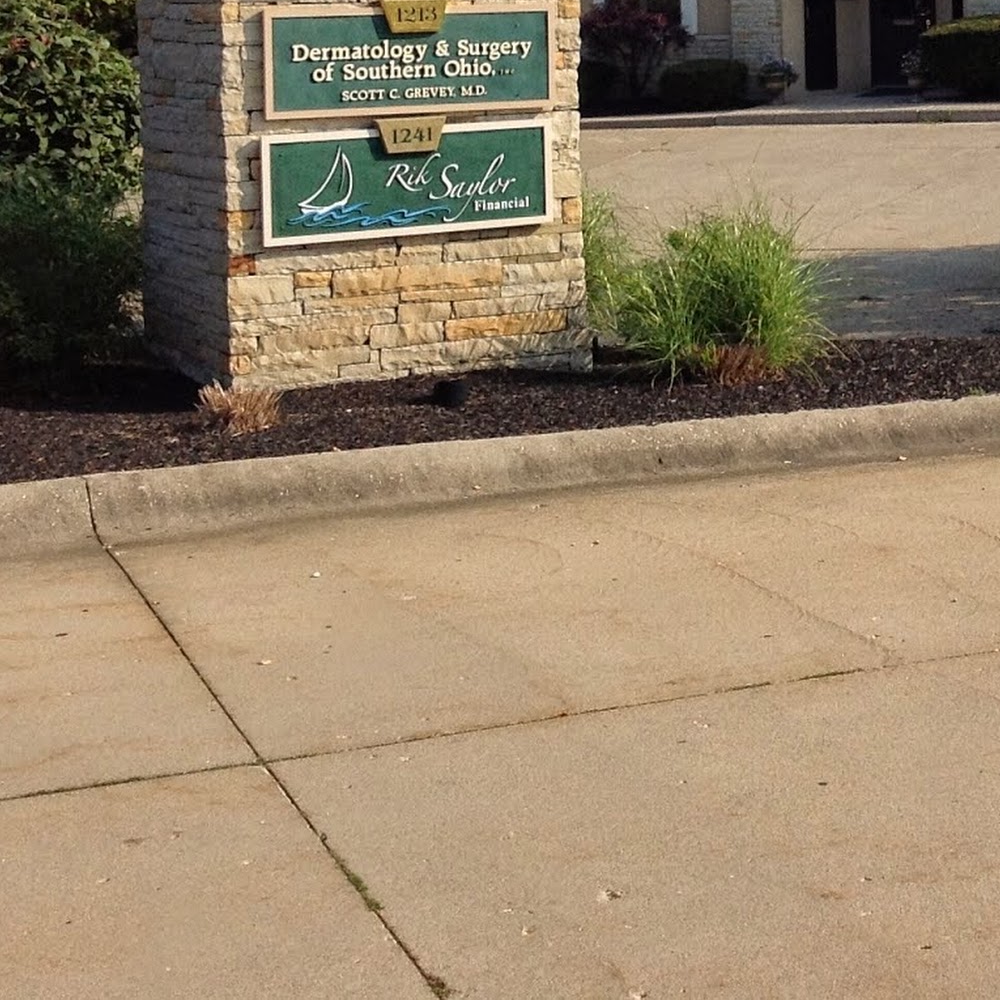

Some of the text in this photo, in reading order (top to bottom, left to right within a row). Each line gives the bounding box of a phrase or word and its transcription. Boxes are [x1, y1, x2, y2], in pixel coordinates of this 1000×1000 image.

[397, 7, 437, 23] 1213
[292, 38, 533, 63] Dermatology & Surgery
[312, 66, 335, 83] of
[343, 60, 437, 81] Southern
[341, 88, 386, 102] SCOTT
[389, 88, 401, 100] C.
[391, 126, 433, 144] 1241
[385, 152, 517, 222] Rik Saylor
[474, 195, 530, 213] Financial
